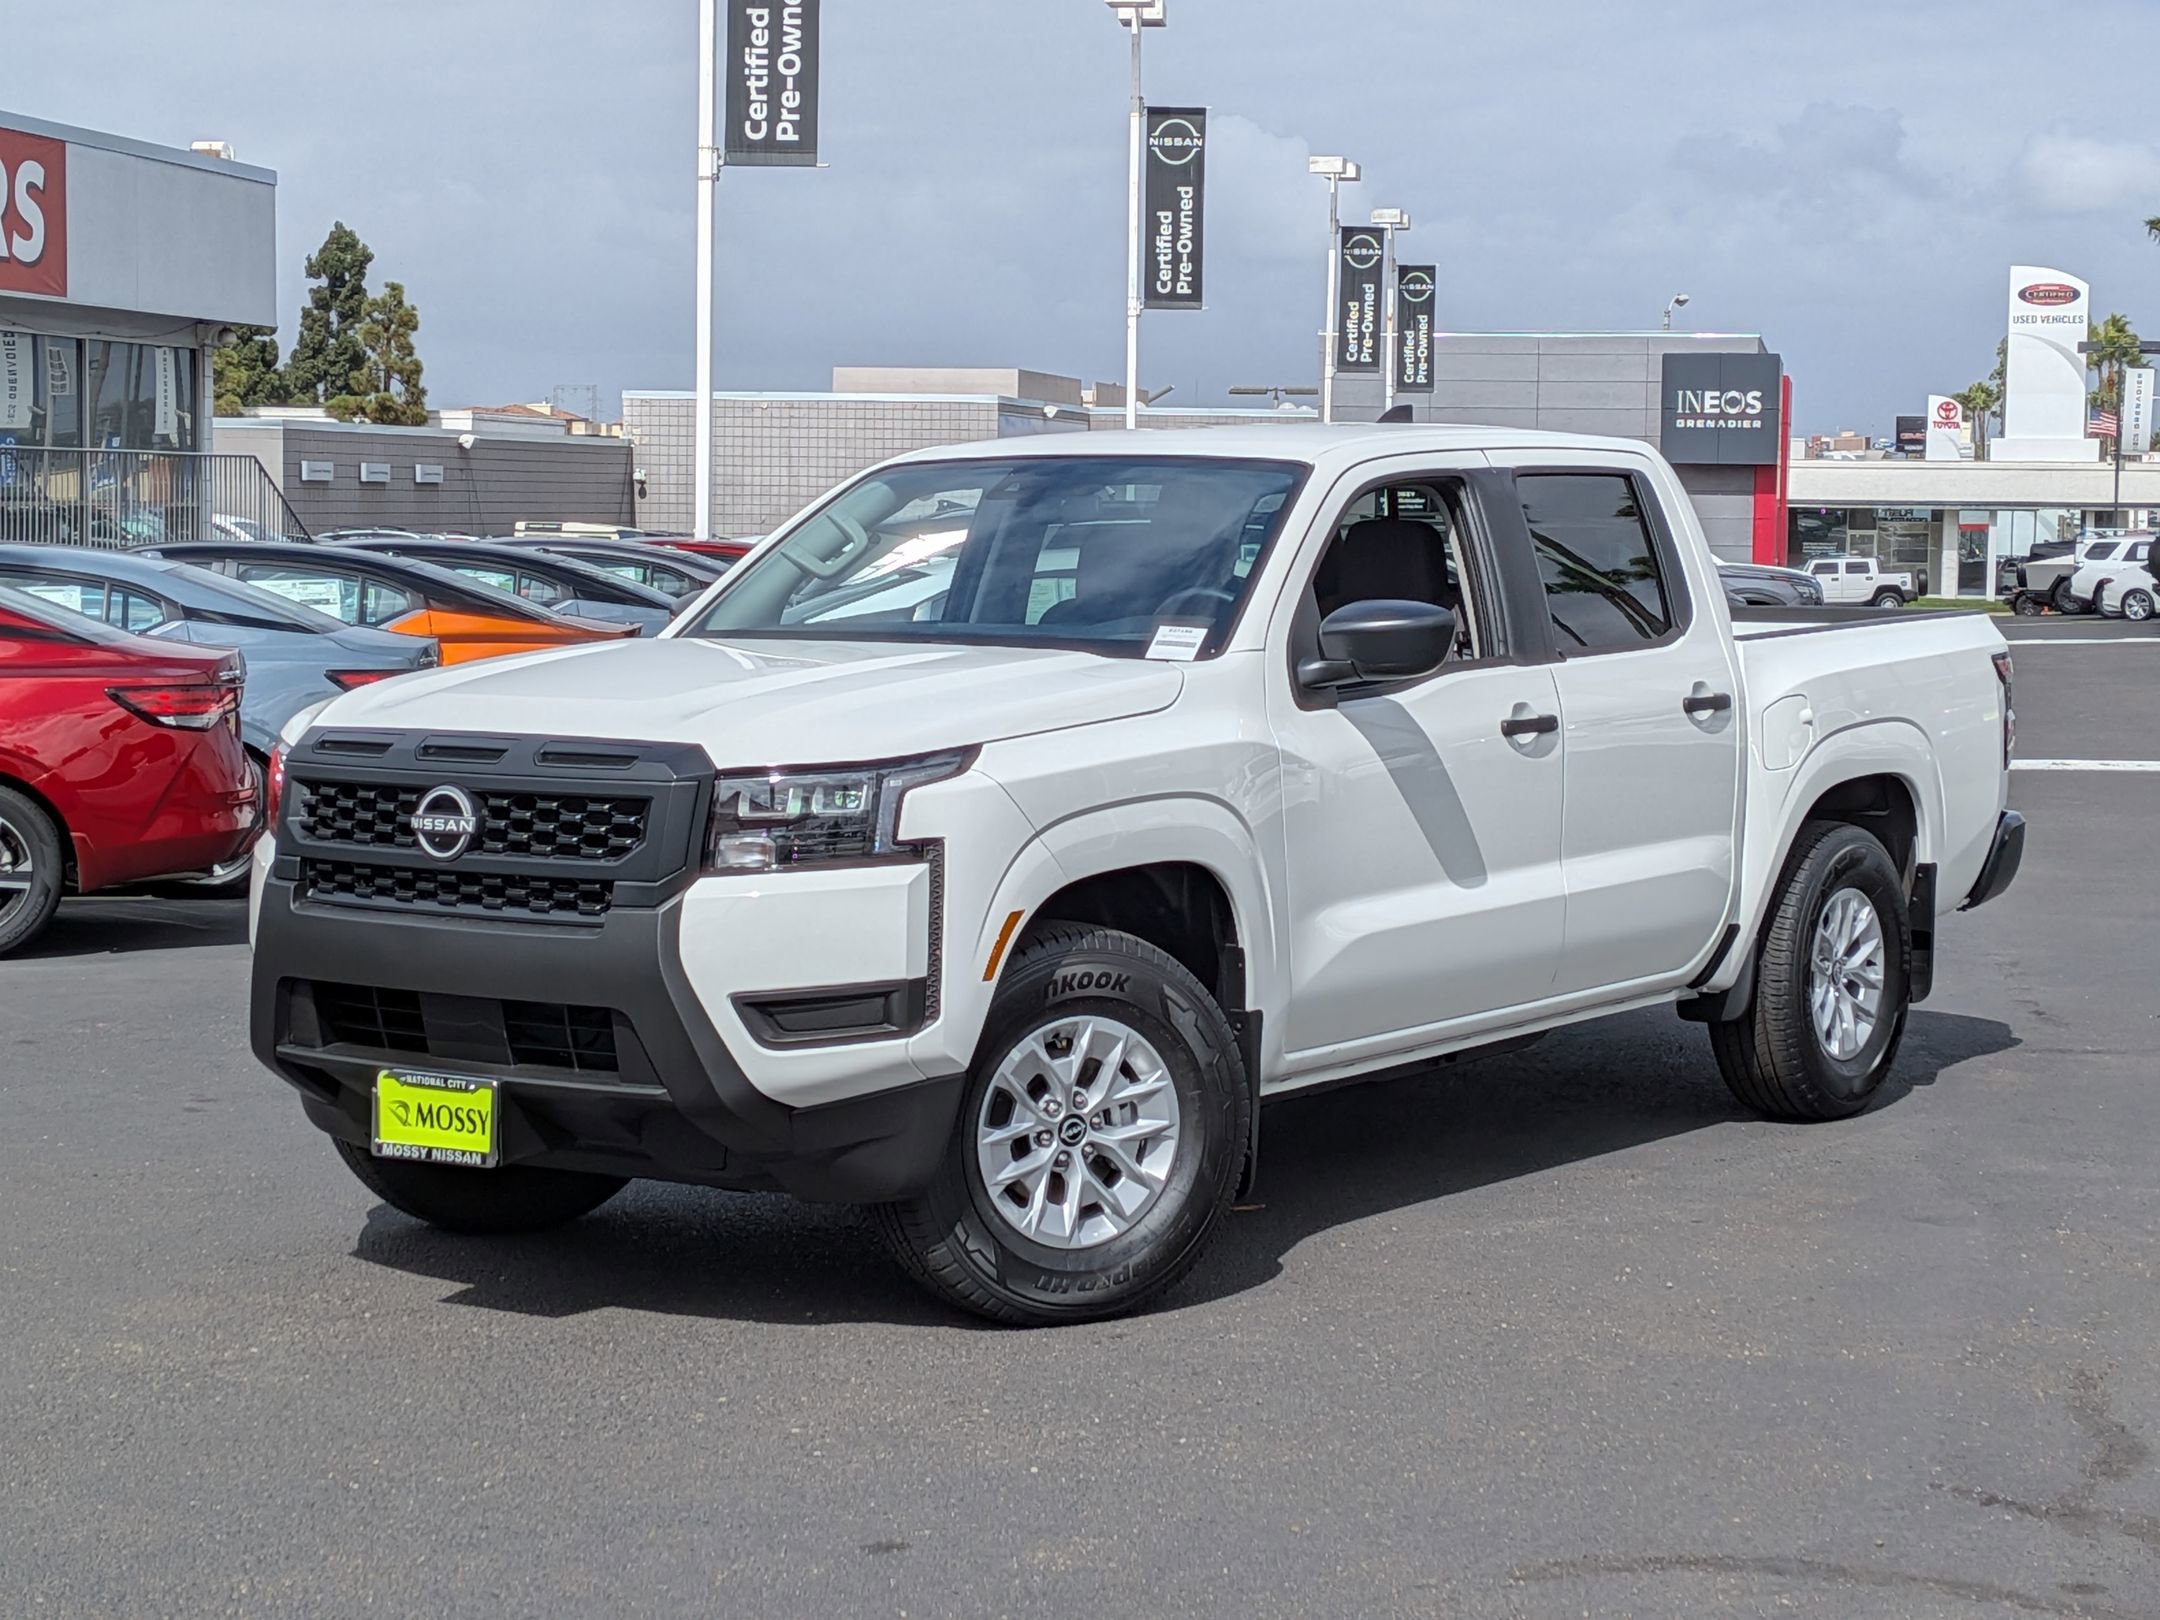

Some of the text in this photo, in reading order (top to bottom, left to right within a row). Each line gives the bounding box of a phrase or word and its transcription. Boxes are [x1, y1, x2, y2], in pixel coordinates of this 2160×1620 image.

[744, 8, 770, 140] Certified
[1149, 137, 1203, 147] NISSAN
[1156, 211, 1173, 294] Certified
[1176, 186, 1194, 294] Pre-Owned
[1343, 248, 1382, 256] NISSAN
[1346, 301, 1360, 363] Certified
[1360, 283, 1375, 363] Pre-Owned
[2012, 315, 2084, 325] USED VEHICLES
[1403, 330, 1415, 383] Certified
[1416, 314, 1429, 383] Pre-Owned
[1676, 390, 1762, 415] INEOS
[1675, 419, 1762, 429] GRENADIER
[1933, 421, 1960, 430] TOYOTA
[410, 816, 473, 832] NISSAN
[406, 1074, 468, 1090] NATIONAL CITY
[415, 1102, 489, 1136] MOSSY
[381, 1143, 482, 1165] MOSSY NISSAN
